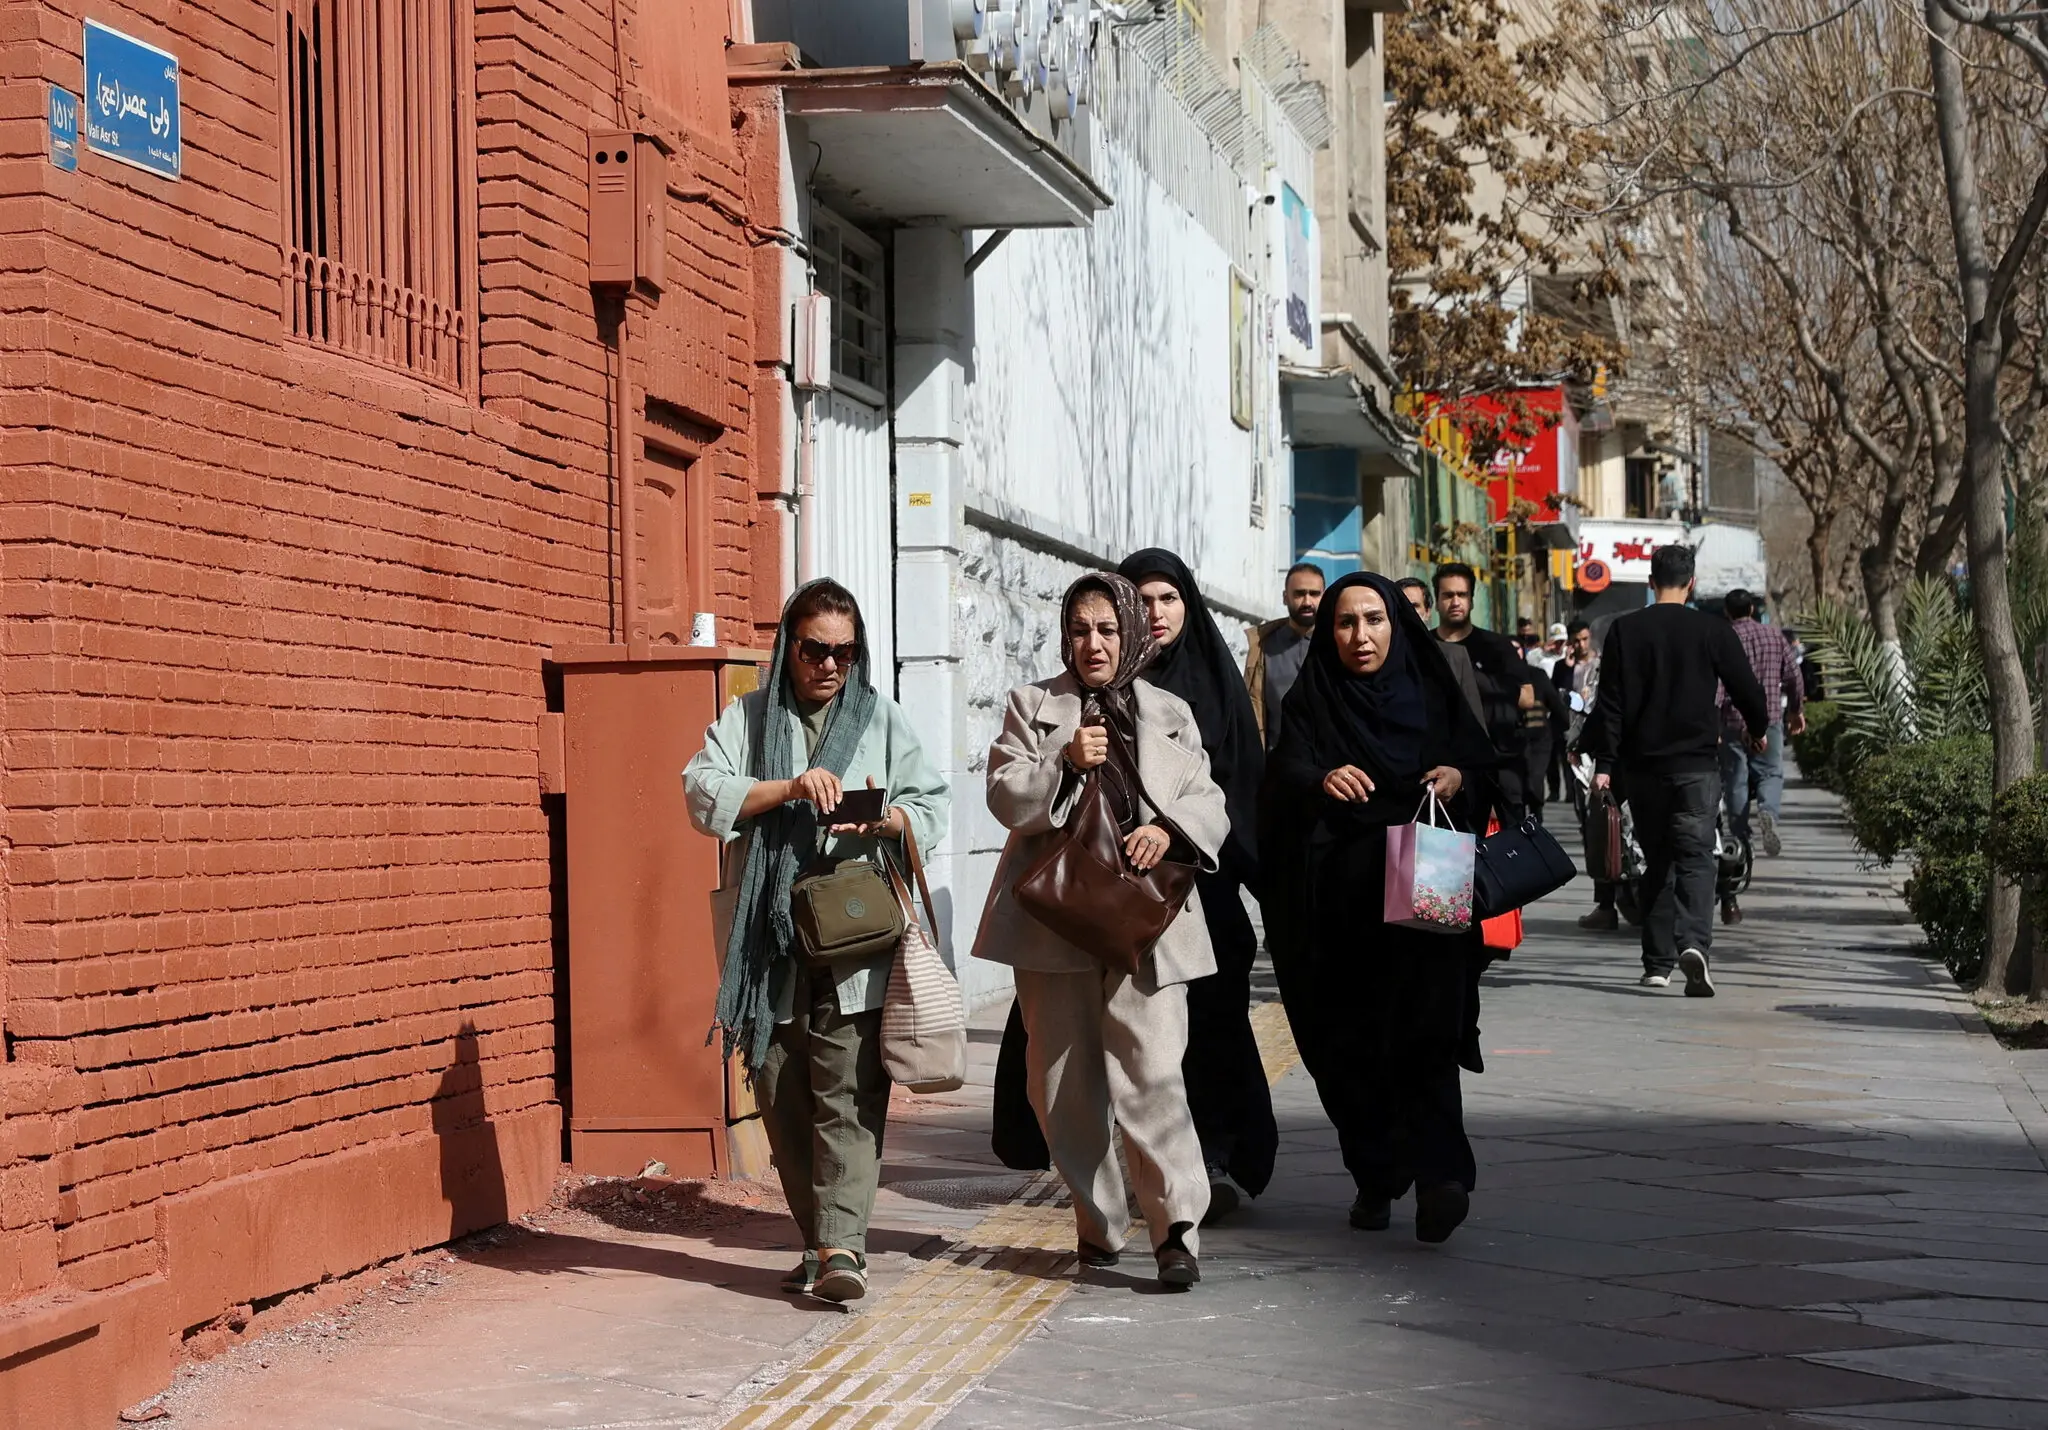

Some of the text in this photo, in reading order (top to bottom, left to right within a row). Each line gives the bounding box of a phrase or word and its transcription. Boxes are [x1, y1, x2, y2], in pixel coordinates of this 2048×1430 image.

[119, 92, 147, 120] عصر
[150, 96, 170, 138] ولی
[100, 126, 111, 143] Asr
